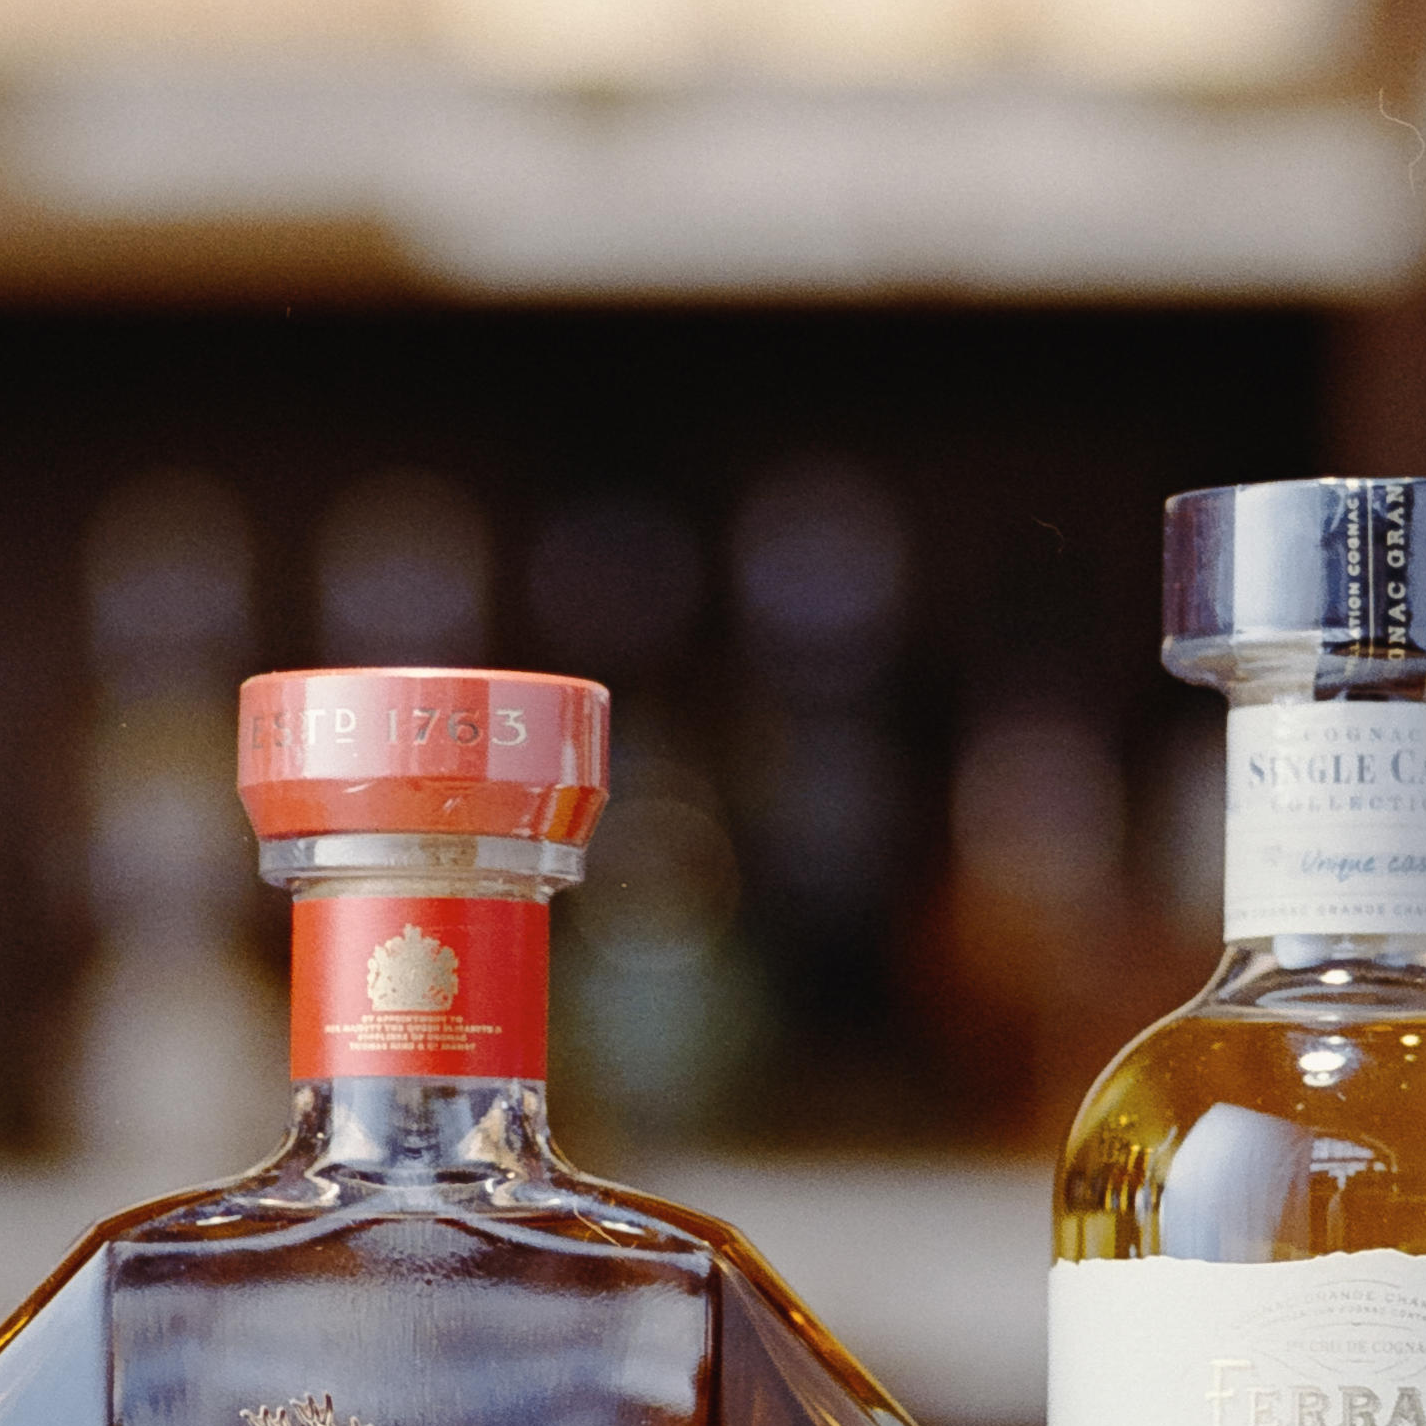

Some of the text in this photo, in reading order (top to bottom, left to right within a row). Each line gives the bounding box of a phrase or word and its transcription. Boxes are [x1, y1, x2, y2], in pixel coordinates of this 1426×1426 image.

[1346, 497, 1361, 577] COGNAC
[386, 707, 527, 747] 1763
[1303, 726, 1422, 743] COGNAC
[1248, 751, 1377, 789] SINGLE
